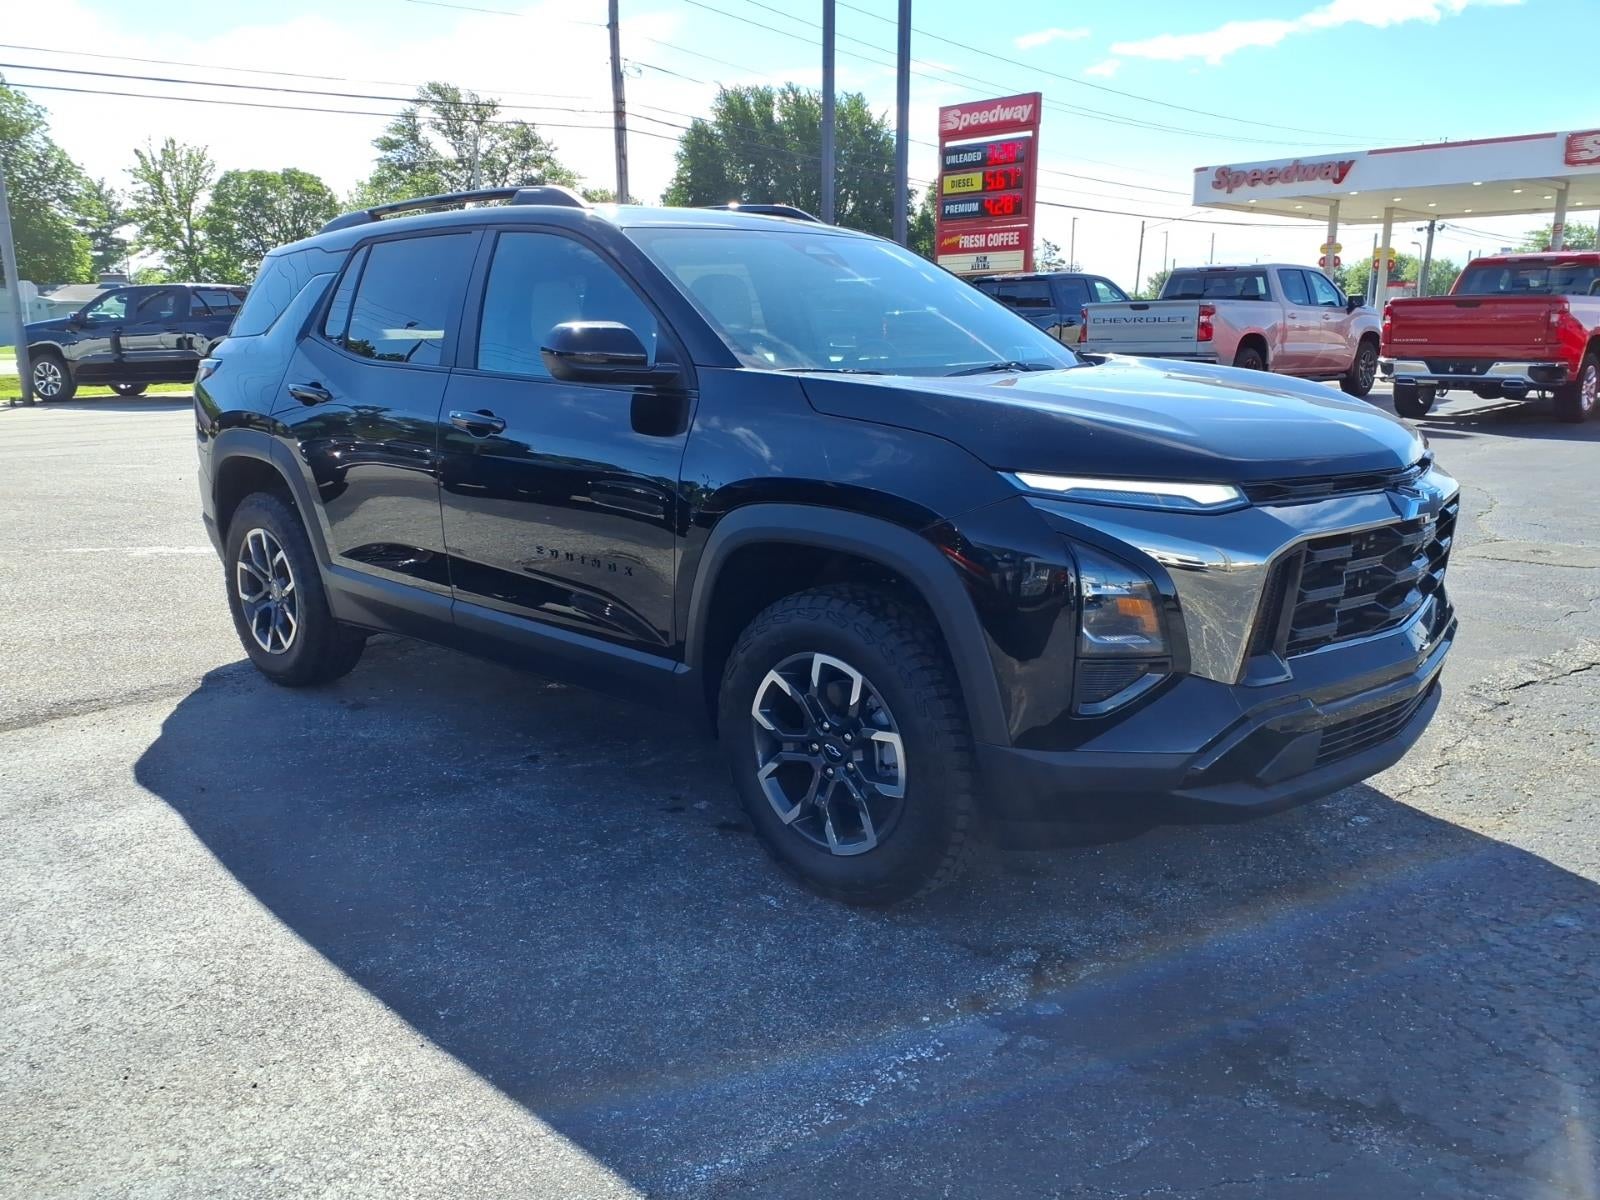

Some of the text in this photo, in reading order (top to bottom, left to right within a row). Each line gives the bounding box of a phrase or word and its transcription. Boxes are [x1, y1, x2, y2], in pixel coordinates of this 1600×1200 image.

[942, 103, 1033, 131] Speedway
[945, 151, 982, 165] UNLEADED
[950, 177, 974, 189] DIESEL
[1211, 159, 1356, 194] Speedway
[944, 202, 979, 214] PREMIUM
[959, 234, 985, 248] FRESH
[987, 232, 1019, 247] COFFEE
[1092, 316, 1187, 324] CHEVROLET
